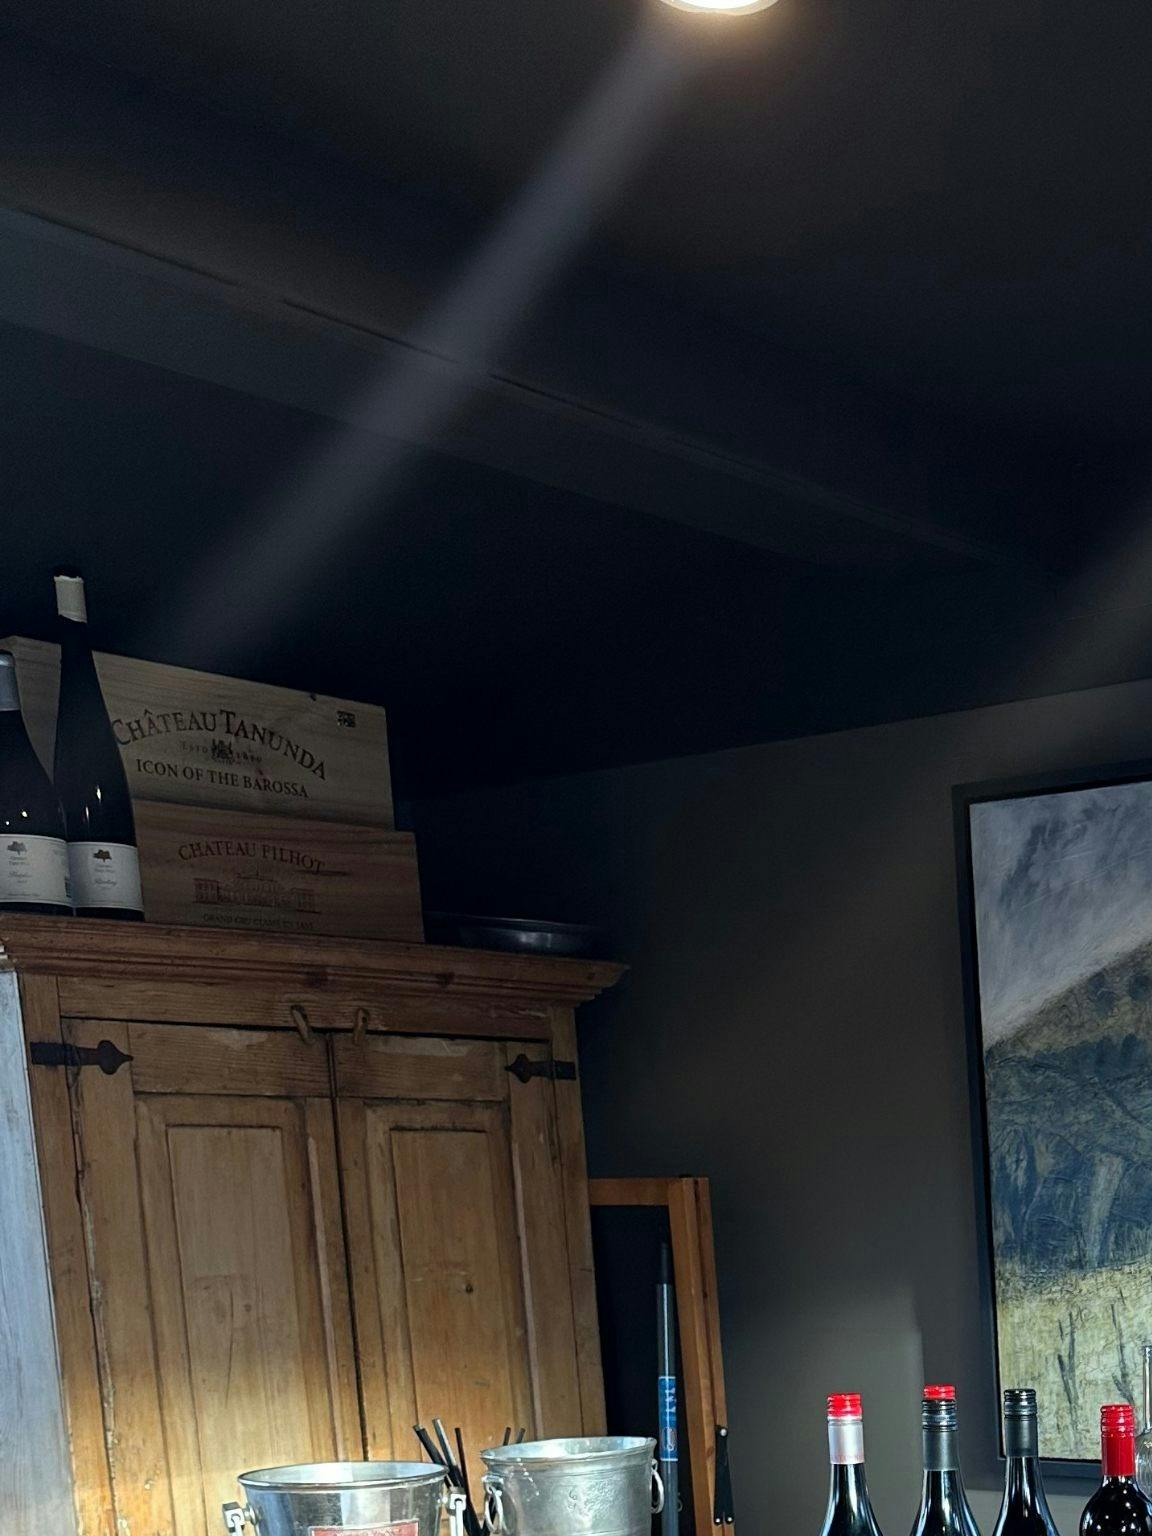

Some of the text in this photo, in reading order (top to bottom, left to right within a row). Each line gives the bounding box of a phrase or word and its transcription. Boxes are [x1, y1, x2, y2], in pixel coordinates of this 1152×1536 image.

[219, 709, 326, 780] TANUNDA
[136, 758, 309, 798] ICON OF THE BAROSSA
[178, 840, 257, 861] CHATEAU
